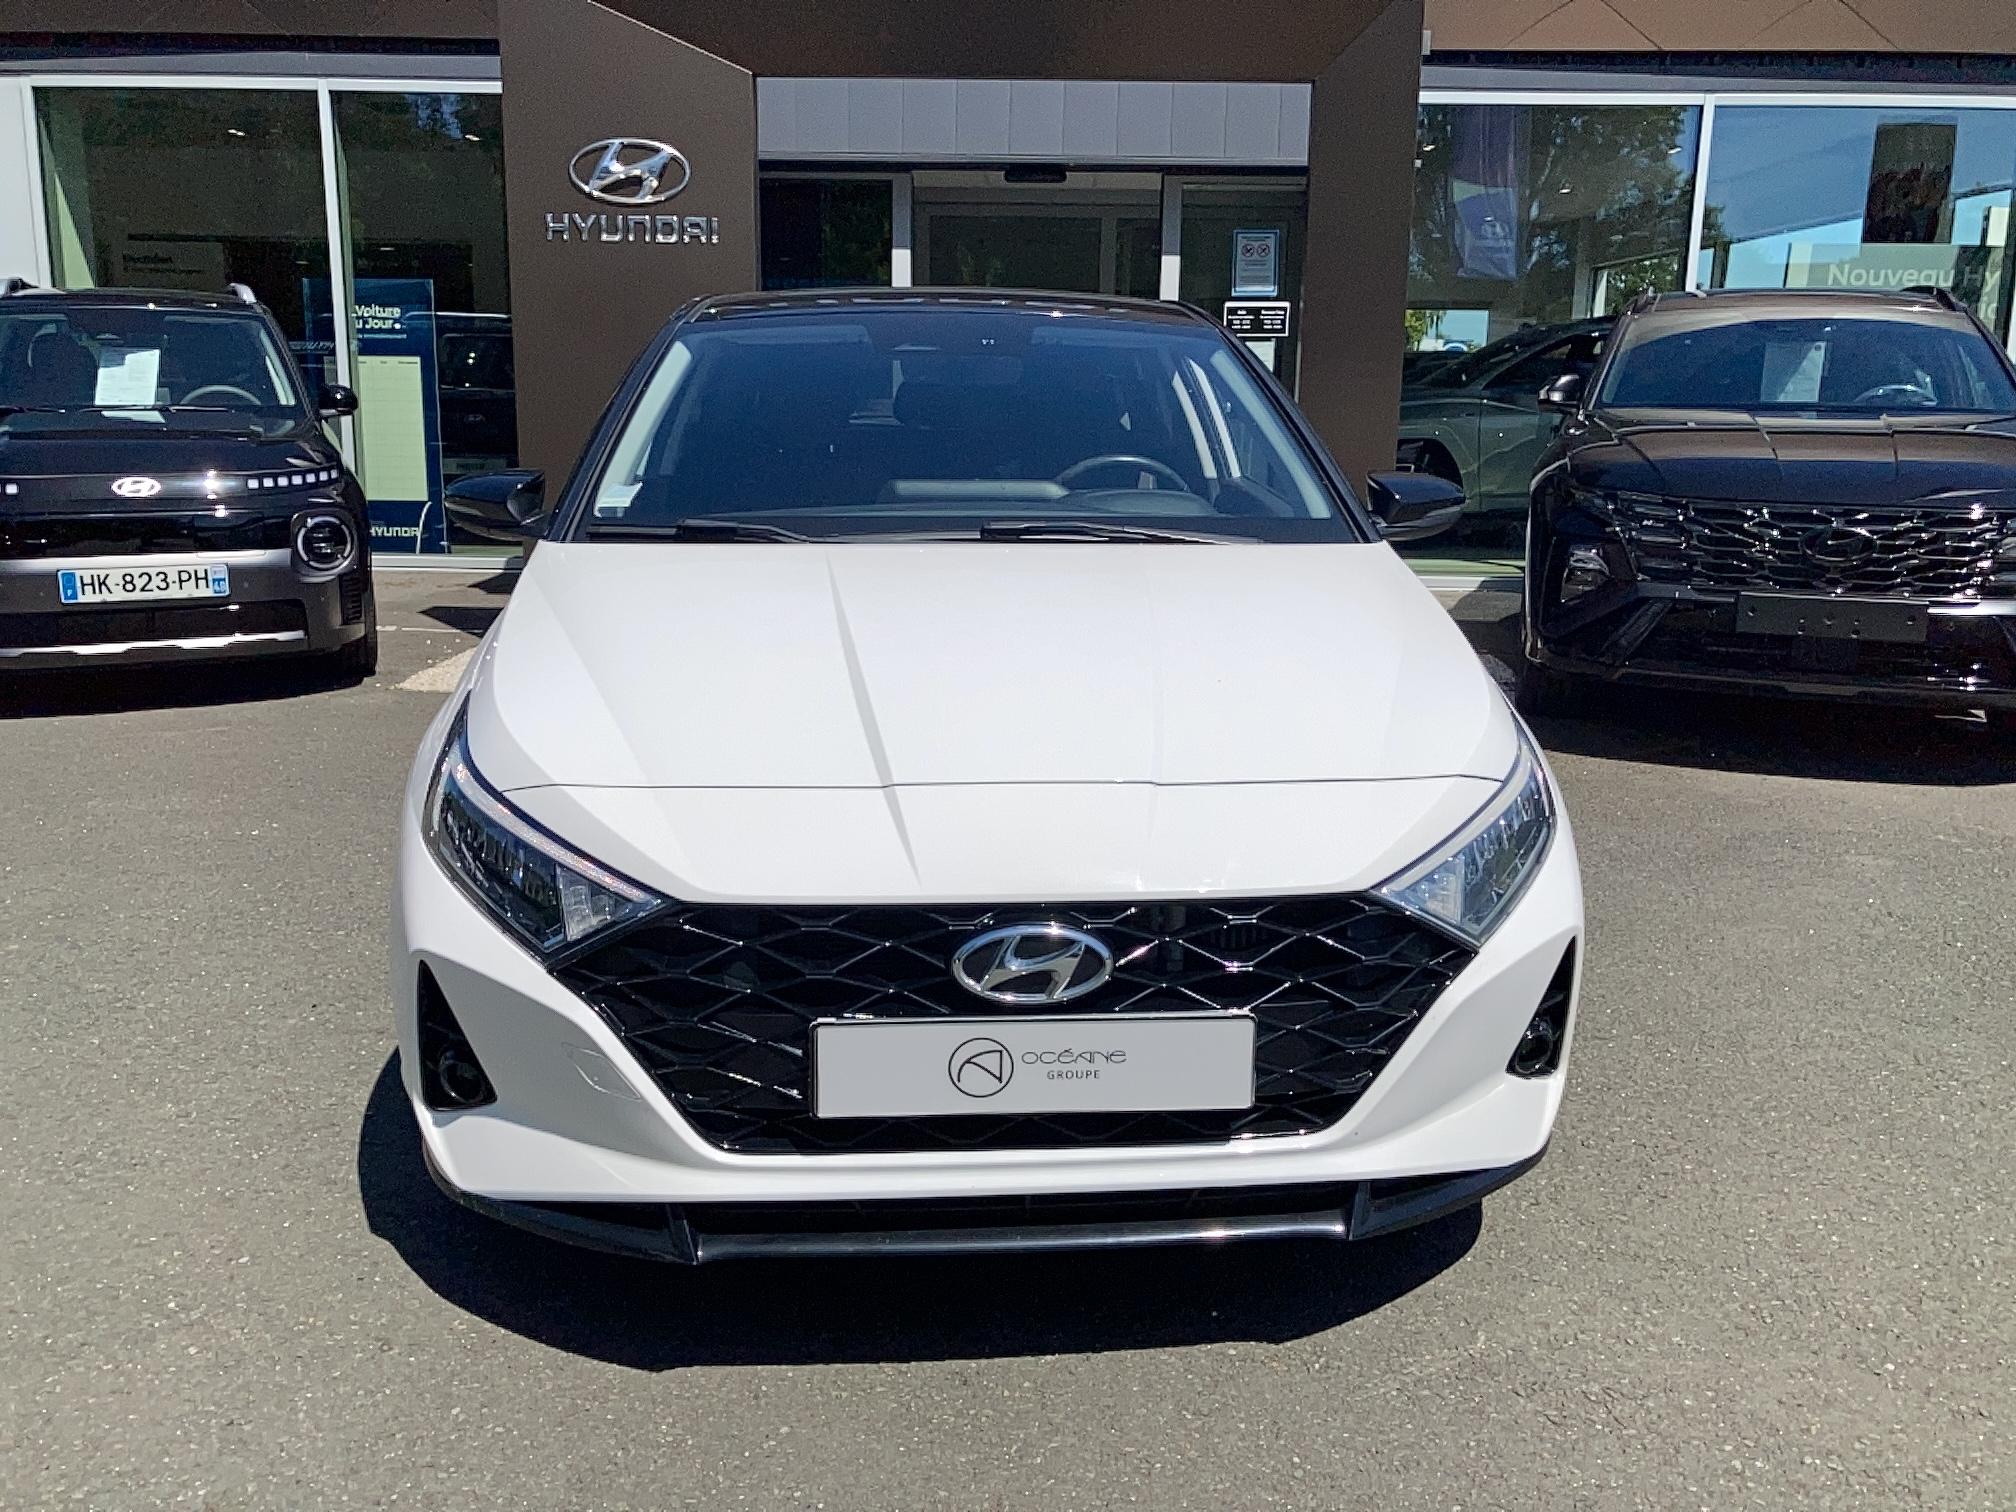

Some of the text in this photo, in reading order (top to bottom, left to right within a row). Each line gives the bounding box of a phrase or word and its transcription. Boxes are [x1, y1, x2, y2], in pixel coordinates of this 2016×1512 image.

[544, 212, 720, 244] HYUNDAI
[1828, 263, 1955, 287] Nouveau
[354, 304, 401, 318] Voiture
[369, 526, 421, 538] HYUNDA
[79, 568, 211, 596] HK-823-PH
[1046, 1069, 1100, 1080] GROUPE
